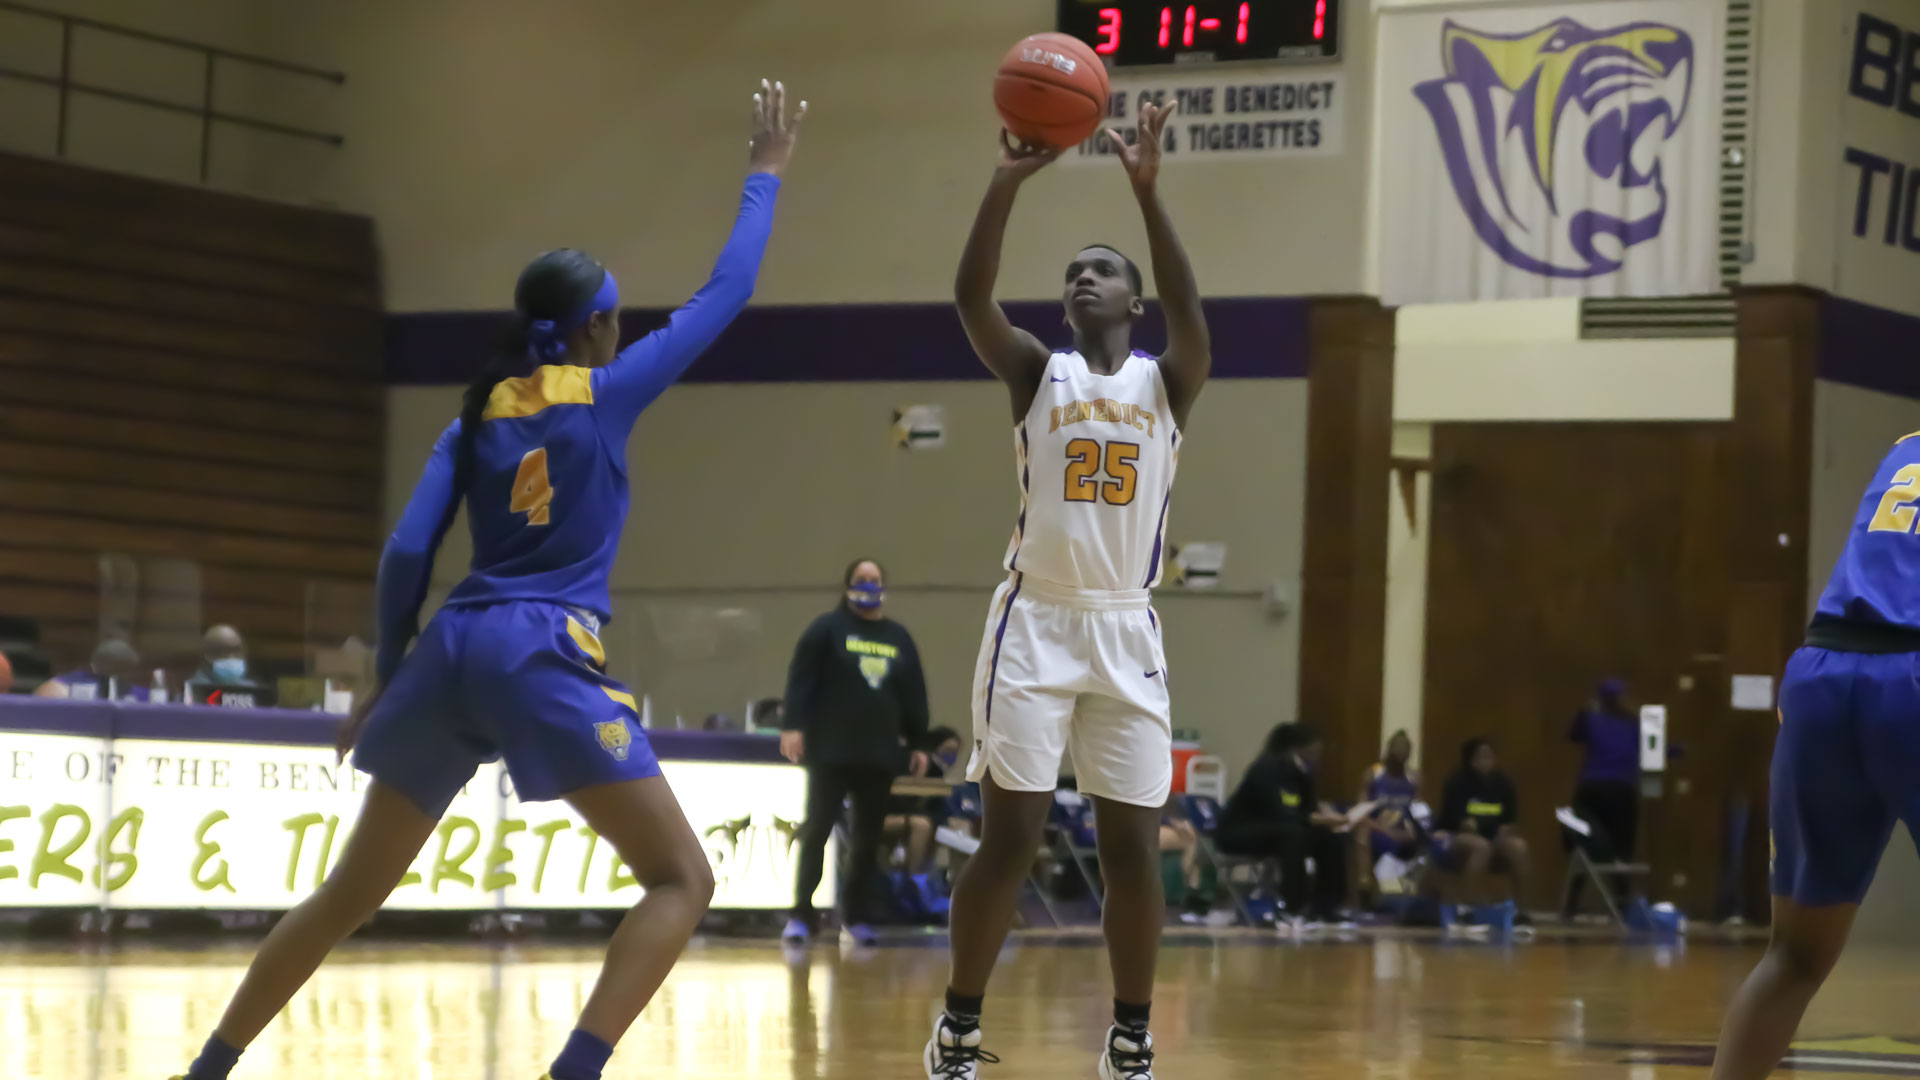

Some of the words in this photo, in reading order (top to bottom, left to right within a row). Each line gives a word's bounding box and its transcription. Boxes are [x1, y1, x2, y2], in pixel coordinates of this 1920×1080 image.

[1176, 87, 1214, 115] THE
[1225, 81, 1334, 114] BENEDICT
[1189, 121, 1320, 151] TIGERETTES
[1048, 398, 1156, 439] BENEDICT
[509, 446, 554, 526] 4
[1064, 437, 1140, 506] 25
[1867, 463, 1920, 534] 2
[65, 752, 125, 784] OF
[147, 757, 231, 789] THE
[190, 810, 236, 893] &
